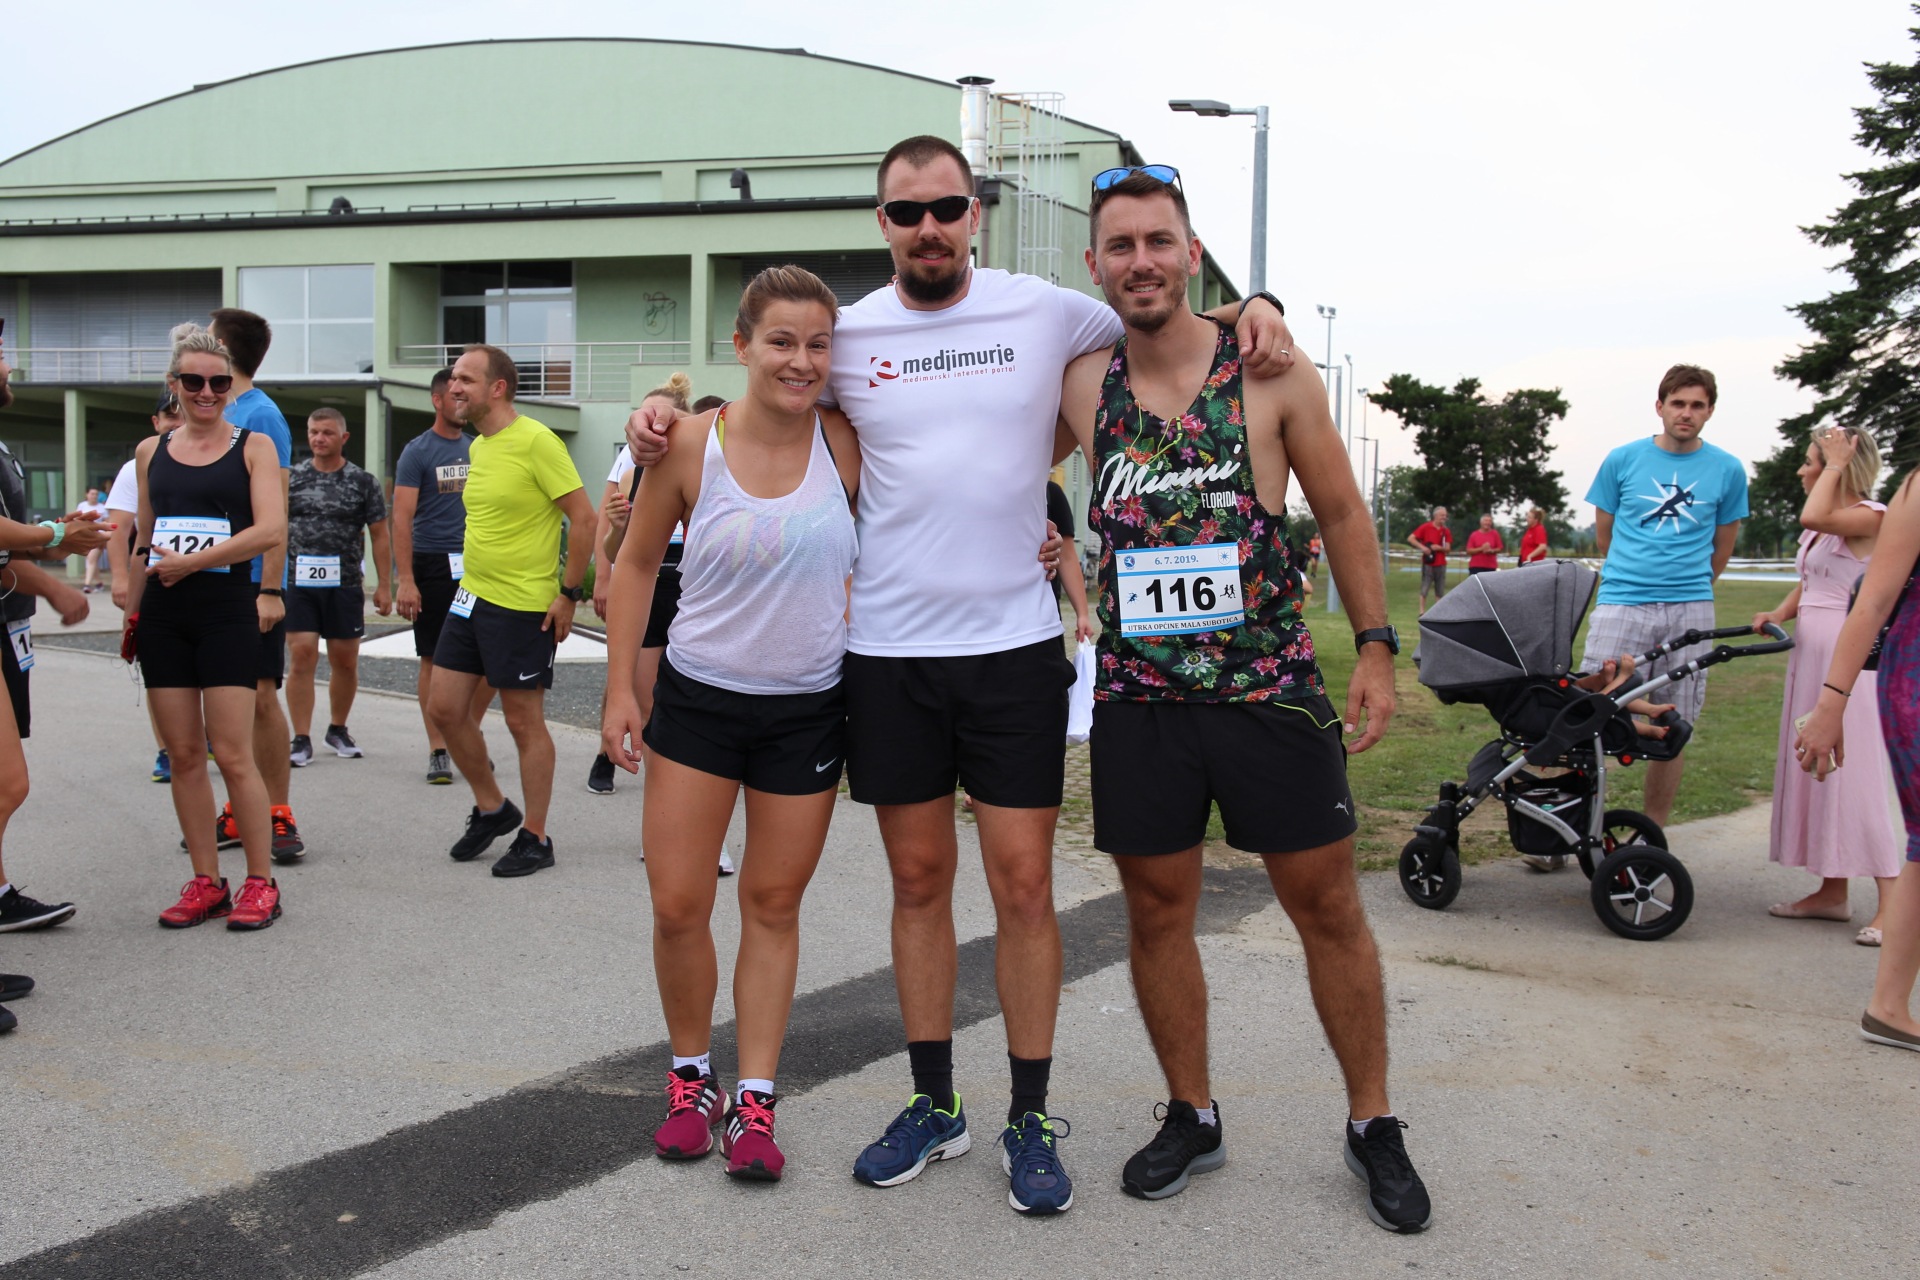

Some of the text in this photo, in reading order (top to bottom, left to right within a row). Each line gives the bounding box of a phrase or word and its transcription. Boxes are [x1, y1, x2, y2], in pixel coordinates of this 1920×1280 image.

[954, 368, 988, 377] internet
[991, 365, 1016, 375] portal
[443, 466, 470, 478] NO GU
[1098, 443, 1242, 511] Miami
[441, 480, 454, 491] NO
[1202, 490, 1238, 509] FLORIDA
[1154, 554, 1199, 565] 6. 7. 2019.
[309, 567, 327, 579] 20
[1145, 576, 1217, 613] 116
[1127, 623, 1153, 632] UTRKA
[1180, 621, 1201, 629] MALA
[1202, 616, 1239, 626] SUBOTICA
